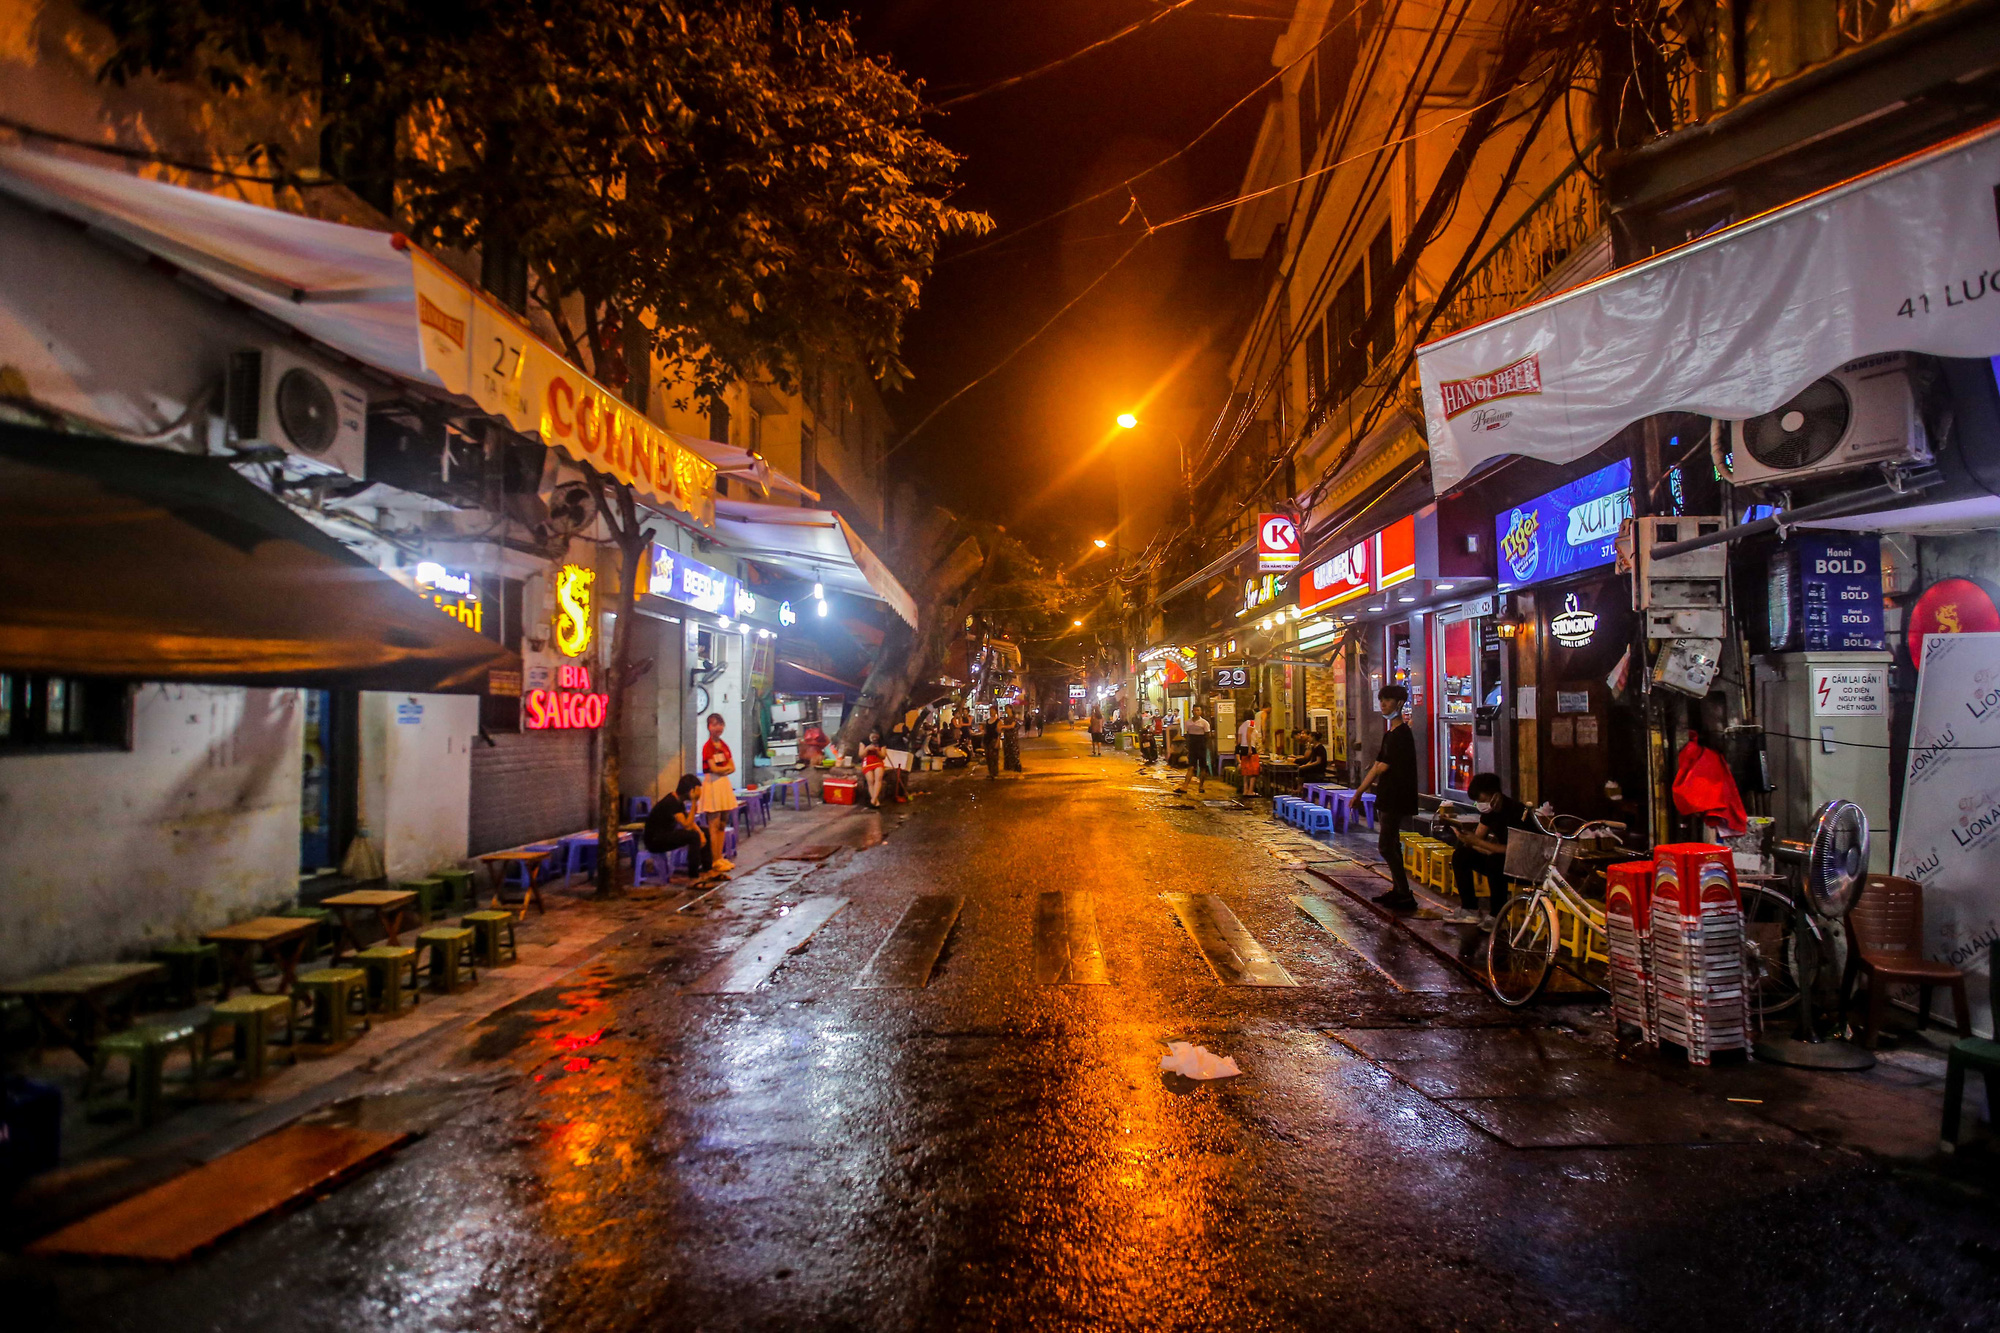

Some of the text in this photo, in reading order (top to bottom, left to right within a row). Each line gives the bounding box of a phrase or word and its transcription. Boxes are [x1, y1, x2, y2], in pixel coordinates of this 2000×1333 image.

[1897, 289, 1930, 318] 41
[493, 336, 527, 380] 27
[1844, 352, 1901, 373] SAMSUNG
[1443, 359, 1540, 415] HANOI BEER
[1271, 525, 1293, 549] K
[1500, 509, 1540, 562] Tiger
[1601, 545, 1610, 558] 37
[1827, 548, 1852, 557] Hanoi
[1815, 559, 1867, 574] BOLD
[1841, 591, 1869, 600] BOLD
[1463, 602, 1480, 616] HSBC
[1552, 616, 1596, 636] STRONGBOW
[1842, 615, 1870, 623] BOLD
[1843, 639, 1871, 647] BOLD
[558, 664, 590, 689] BIA
[1218, 670, 1246, 686] 29
